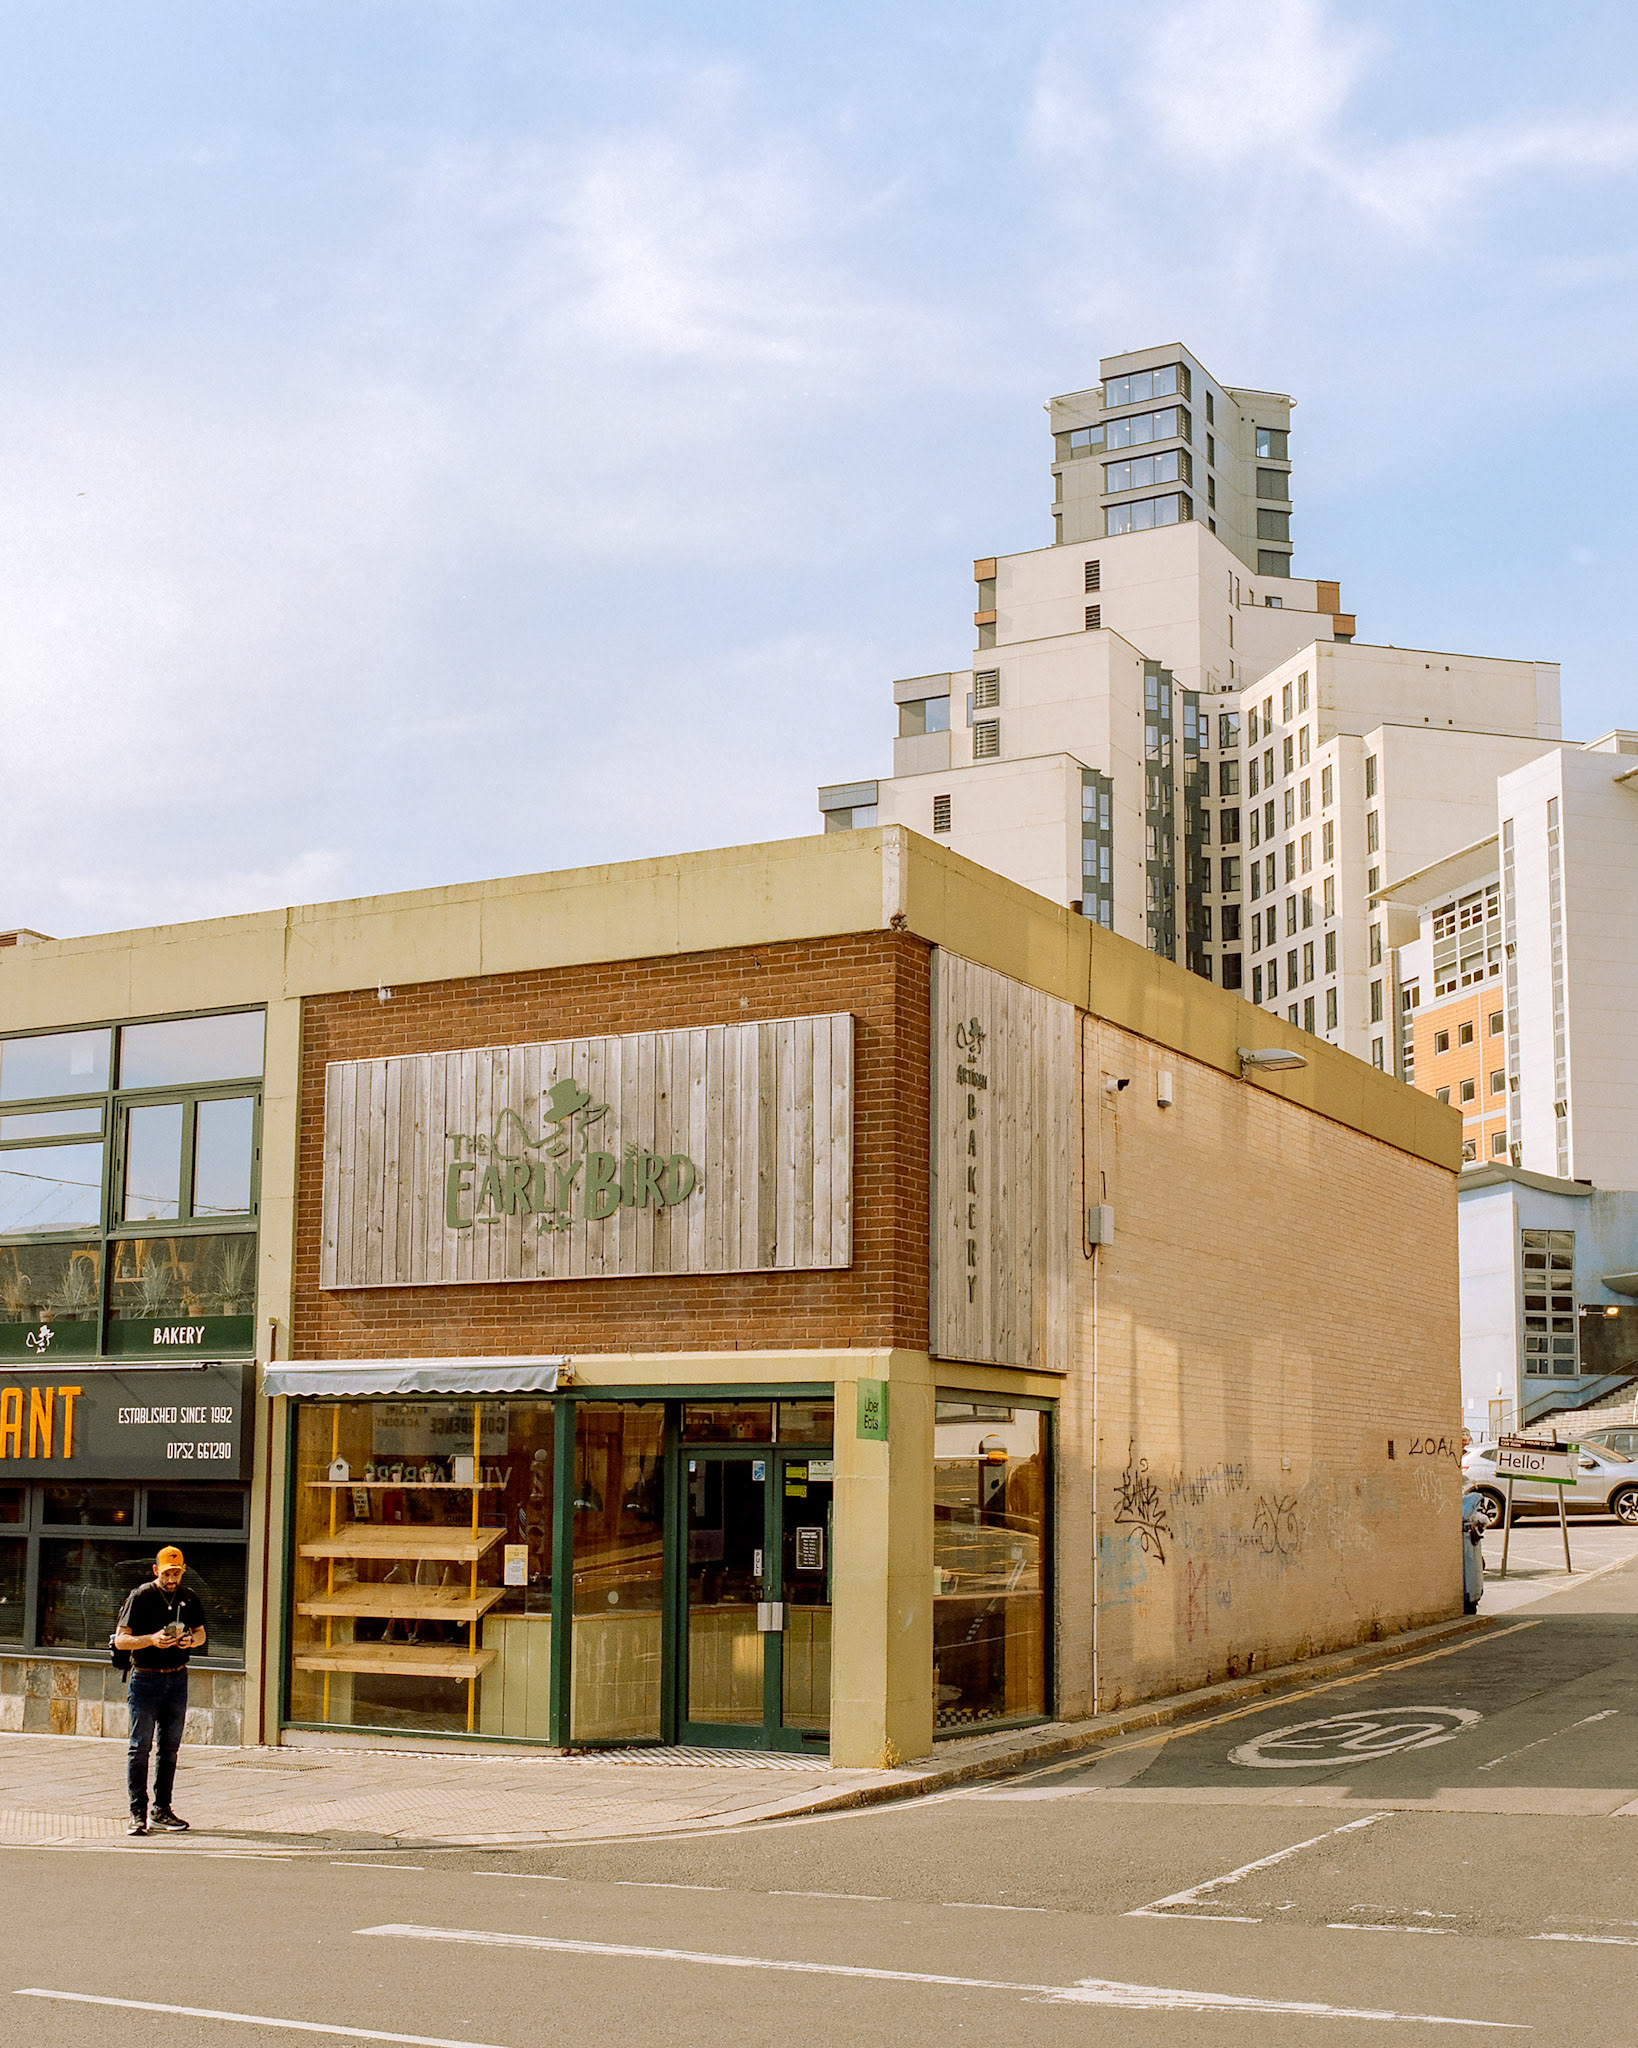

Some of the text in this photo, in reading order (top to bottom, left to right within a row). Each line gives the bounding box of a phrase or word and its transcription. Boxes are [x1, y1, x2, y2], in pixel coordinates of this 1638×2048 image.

[449, 1134, 488, 1159] THE
[447, 1143, 695, 1228] EARLY BIRD
[967, 1093, 977, 1303] BAKERY
[153, 1326, 206, 1345] BAKERY
[864, 1396, 879, 1413] Uber
[118, 1406, 233, 1424] ESTABLISHED SINCE 1992
[864, 1414, 879, 1430] Eats
[167, 1442, 232, 1460] 01752 661290
[1499, 1452, 1545, 1471] Hello!
[1257, 1722, 1446, 1750] 20
